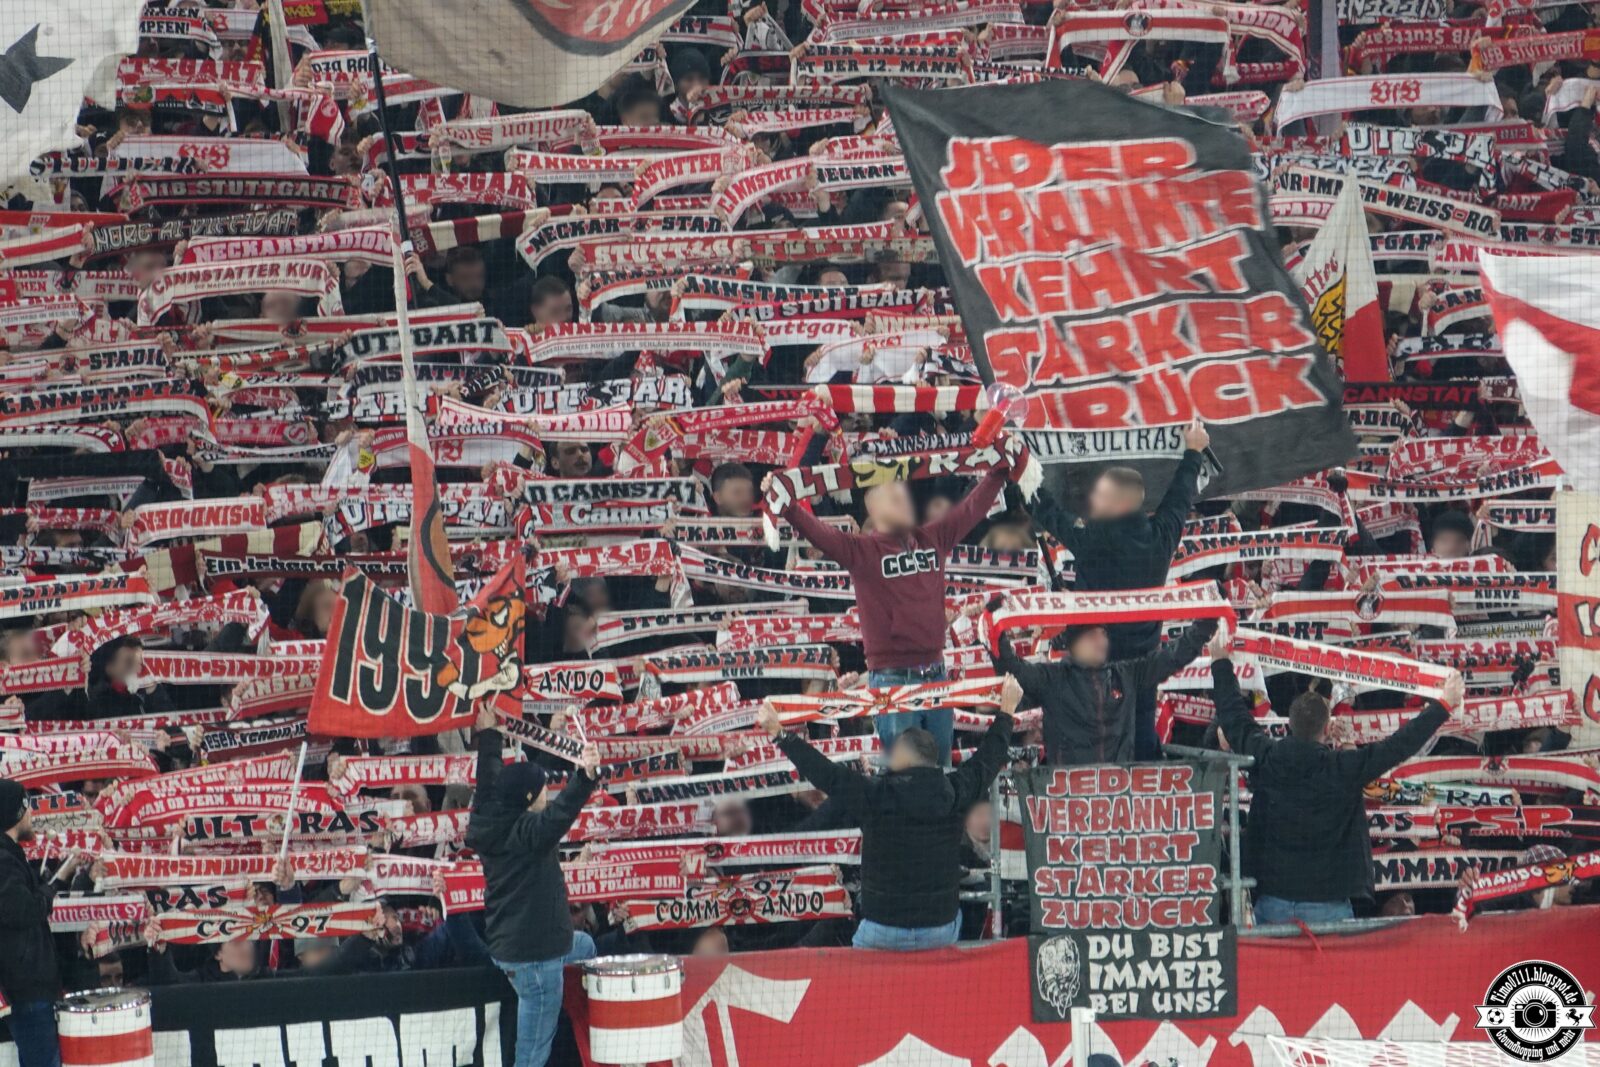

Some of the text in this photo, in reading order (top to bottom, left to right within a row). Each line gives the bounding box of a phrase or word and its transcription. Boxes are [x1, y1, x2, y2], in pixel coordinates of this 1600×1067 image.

[823, 60, 859, 72] DER
[151, 261, 282, 295] CANNSTATTER
[1092, 427, 1184, 451] ULTRAS
[881, 548, 941, 578] CC97
[1239, 546, 1282, 558] KURVE
[1473, 589, 1521, 601] KURVE
[1258, 655, 1291, 669] ULTRAS
[1292, 661, 1312, 672] SEIN
[1345, 670, 1379, 685] ULTRAS
[1046, 765, 1194, 796] JEDER
[1026, 792, 1215, 834] VERBANNTE
[1046, 831, 1200, 865] KEHRT
[1034, 863, 1218, 898] STÄRKER
[761, 891, 825, 917] ANDO
[1040, 895, 1214, 931] ZURÜCK
[196, 914, 331, 938] CC 97
[1086, 930, 1225, 960] DU BIST
[1088, 960, 1226, 992] IMMER
[1089, 989, 1229, 1014] BEI UNS!
